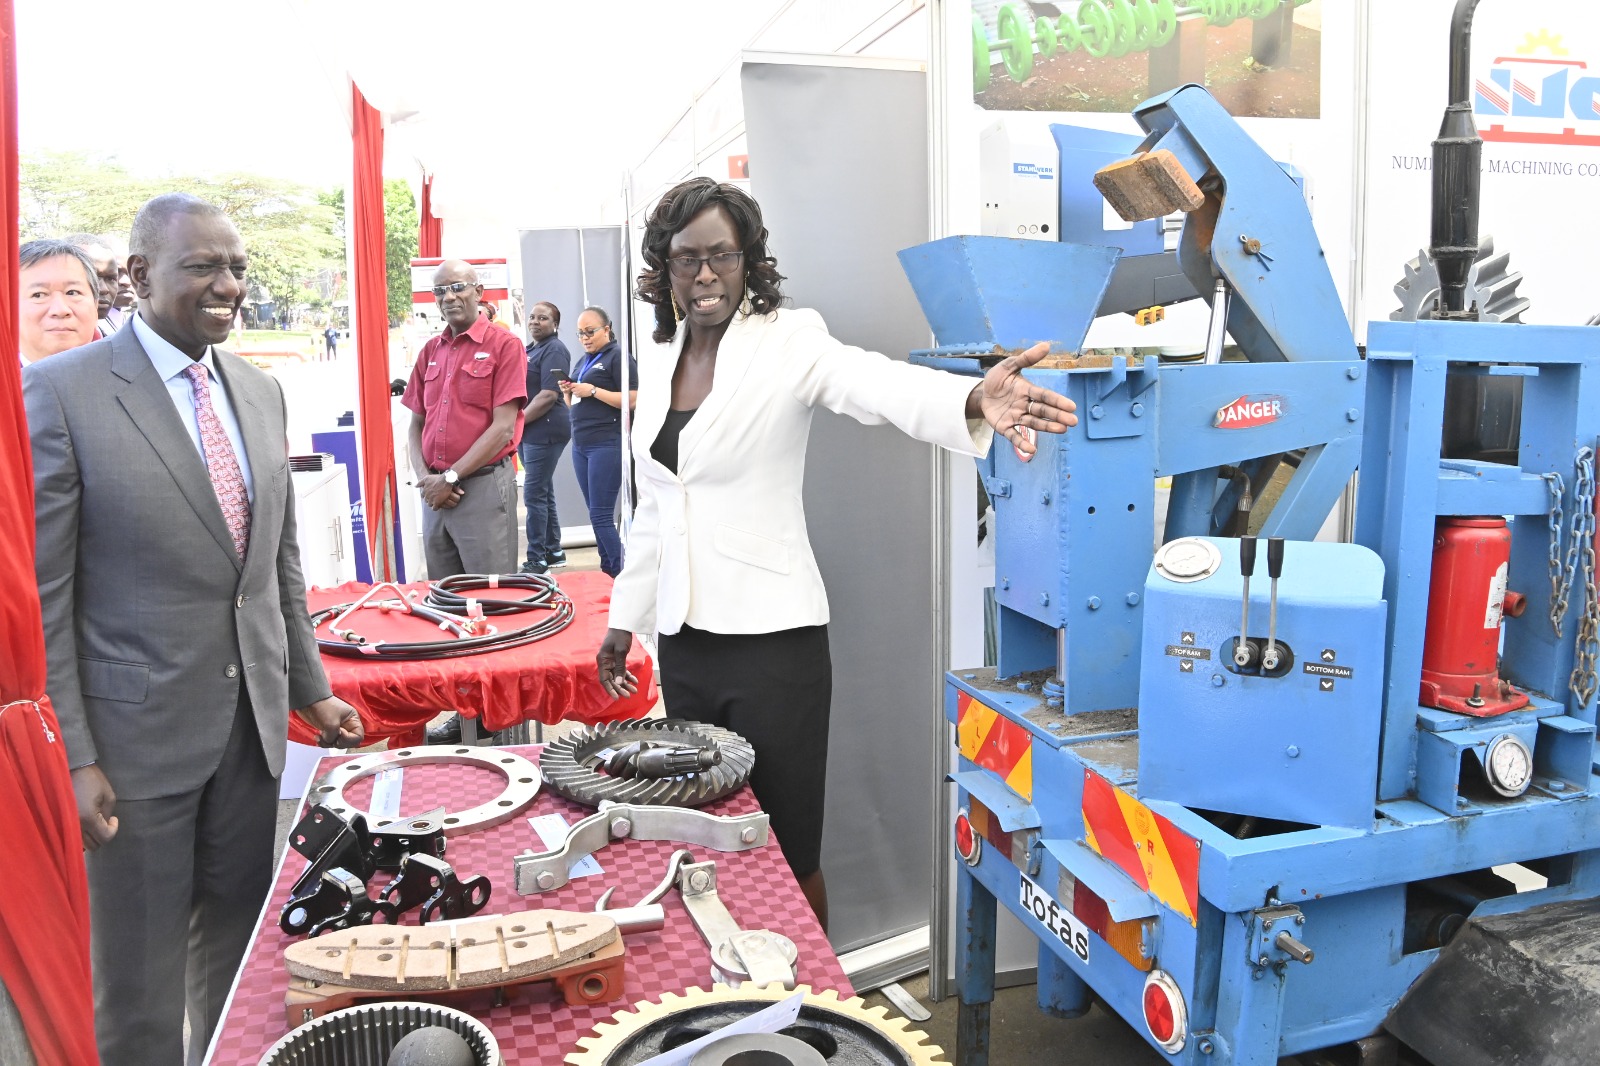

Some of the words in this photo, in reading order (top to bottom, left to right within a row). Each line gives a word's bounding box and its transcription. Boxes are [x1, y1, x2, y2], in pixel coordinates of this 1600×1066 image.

[1489, 159, 1573, 176] MACHINING
[1187, 649, 1201, 657] RAM
[1306, 665, 1334, 674] BOTTOM
[1335, 668, 1350, 676] RAM
[1147, 839, 1155, 856] R
[1020, 874, 1089, 961] Tofas
